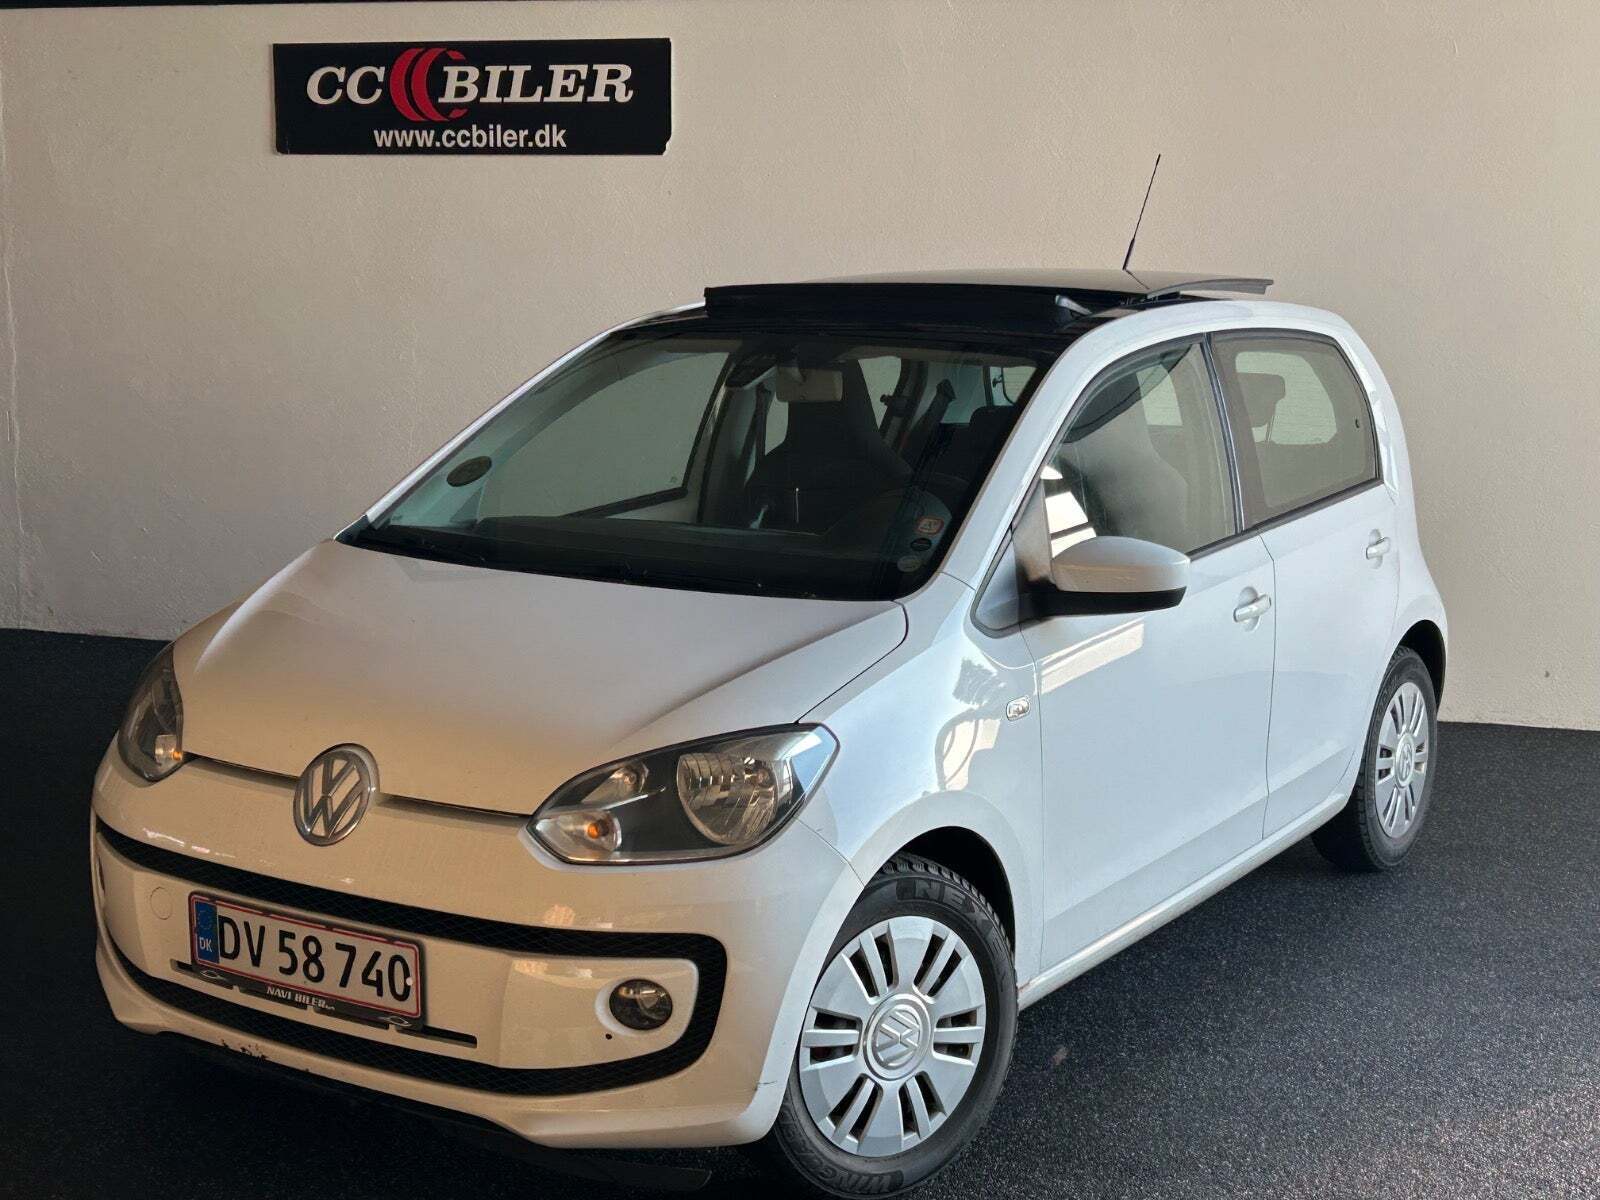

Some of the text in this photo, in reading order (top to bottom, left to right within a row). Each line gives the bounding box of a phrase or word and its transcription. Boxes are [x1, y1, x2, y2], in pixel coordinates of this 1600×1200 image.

[438, 63, 633, 103] BILER
[374, 124, 567, 148] www.ccbiler.dk
[199, 937, 213, 953] DK
[218, 915, 412, 1002] DV 58 740
[266, 986, 292, 1000] NAVI
